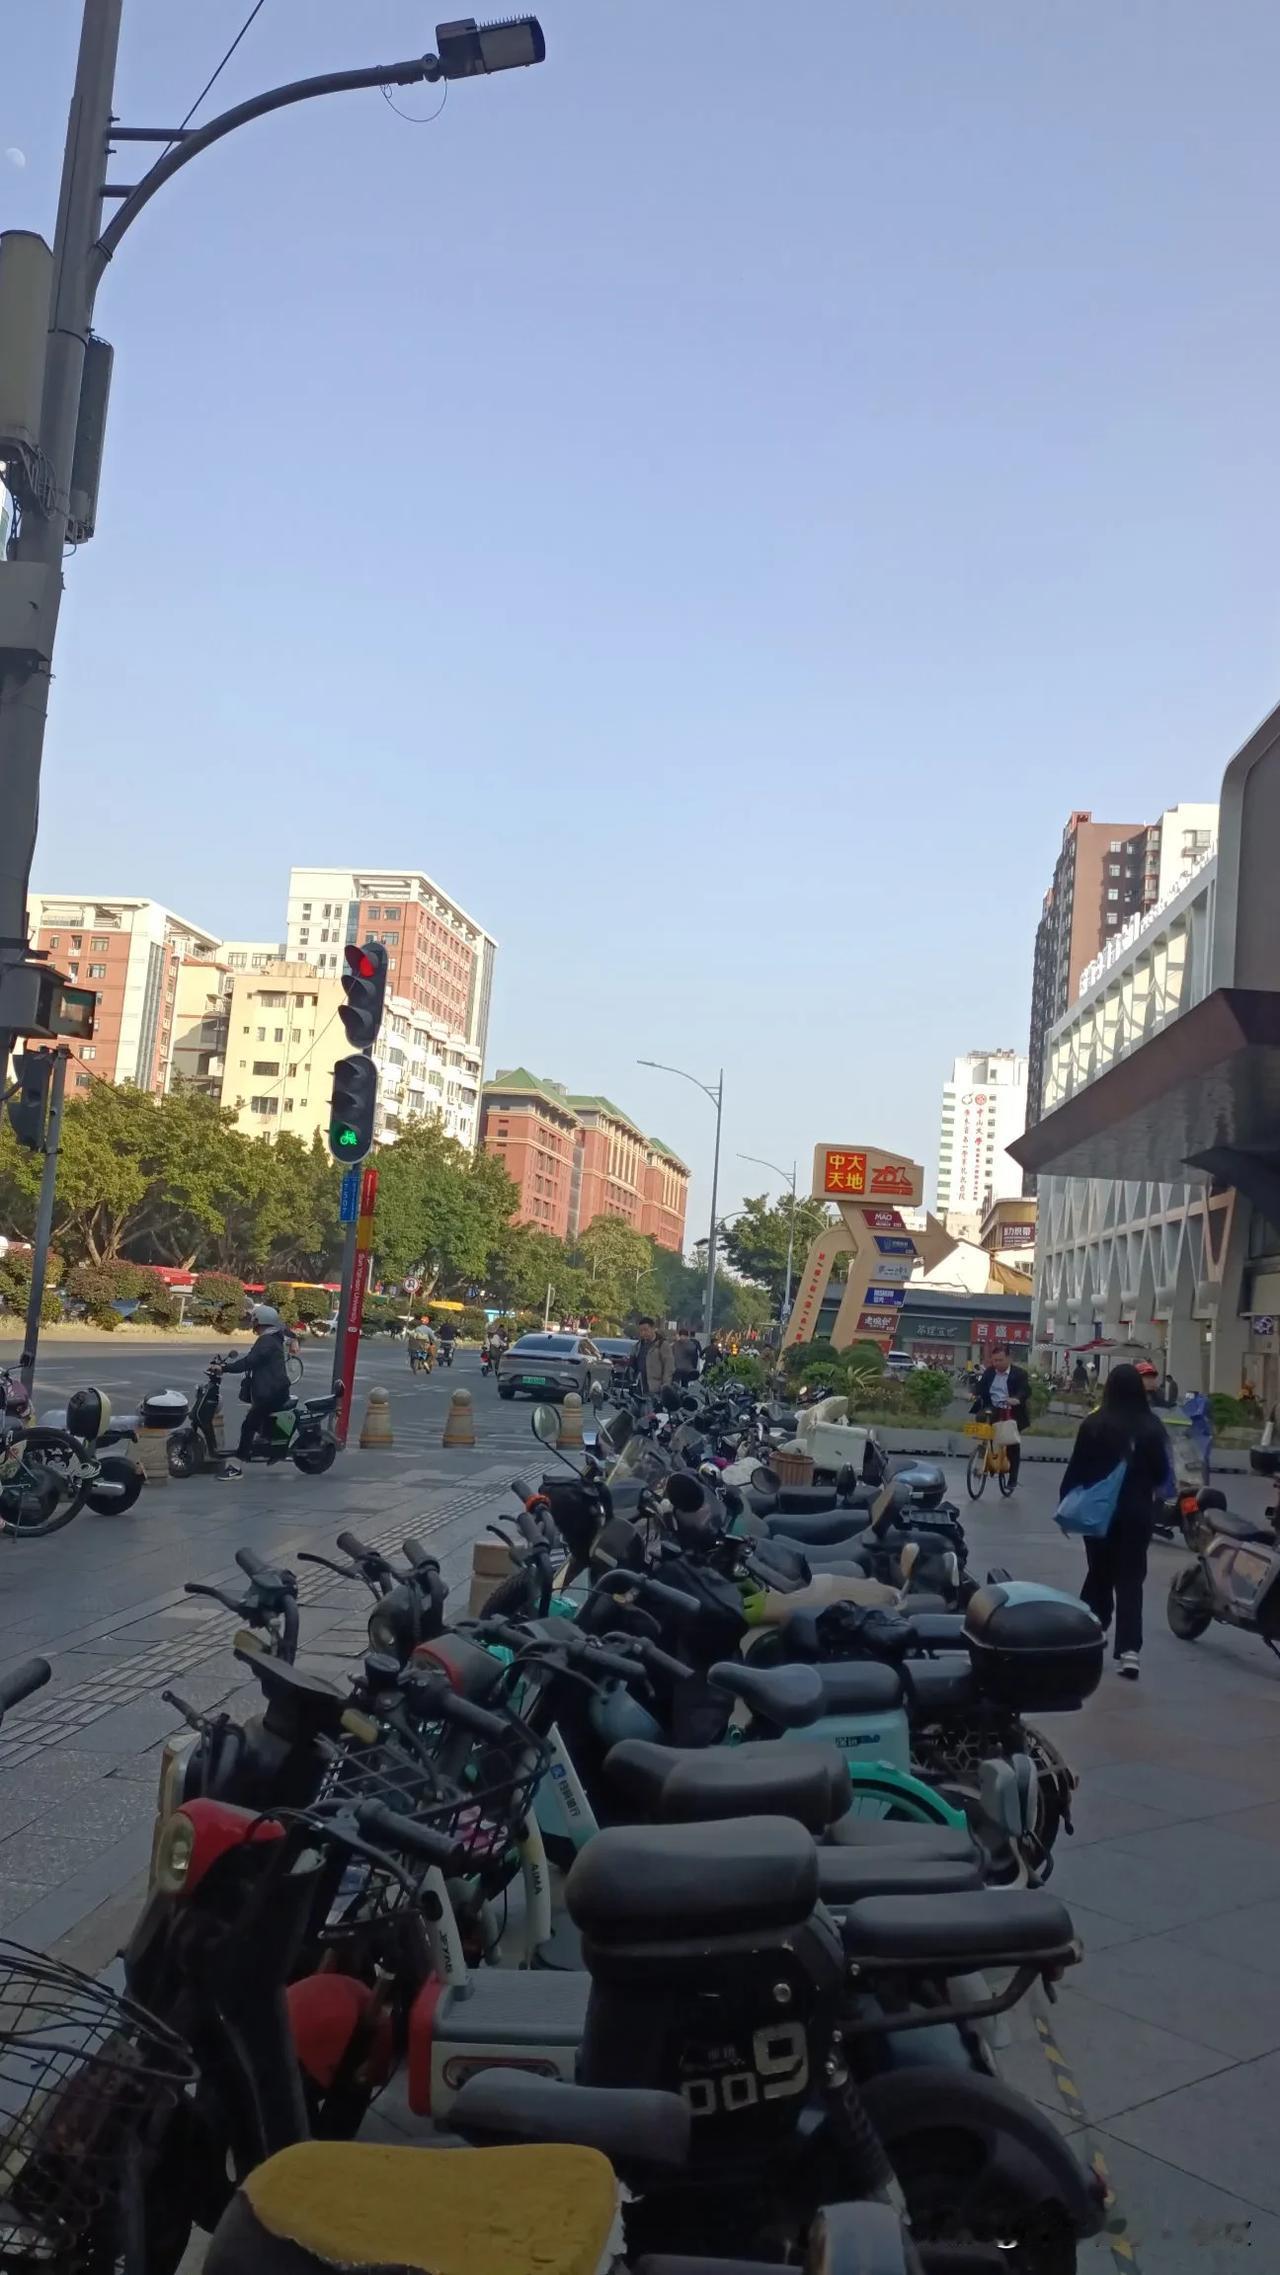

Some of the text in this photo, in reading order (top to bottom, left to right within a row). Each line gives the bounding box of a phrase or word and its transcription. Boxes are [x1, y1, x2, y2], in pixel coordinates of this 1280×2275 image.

[829, 1154, 864, 1171] 中大
[827, 1172, 863, 1190] 天地
[874, 1213, 892, 1221] MAO
[357, 1253, 365, 1266] Sun
[355, 1267, 363, 1291] Yat-sen
[350, 1292, 360, 1323] University
